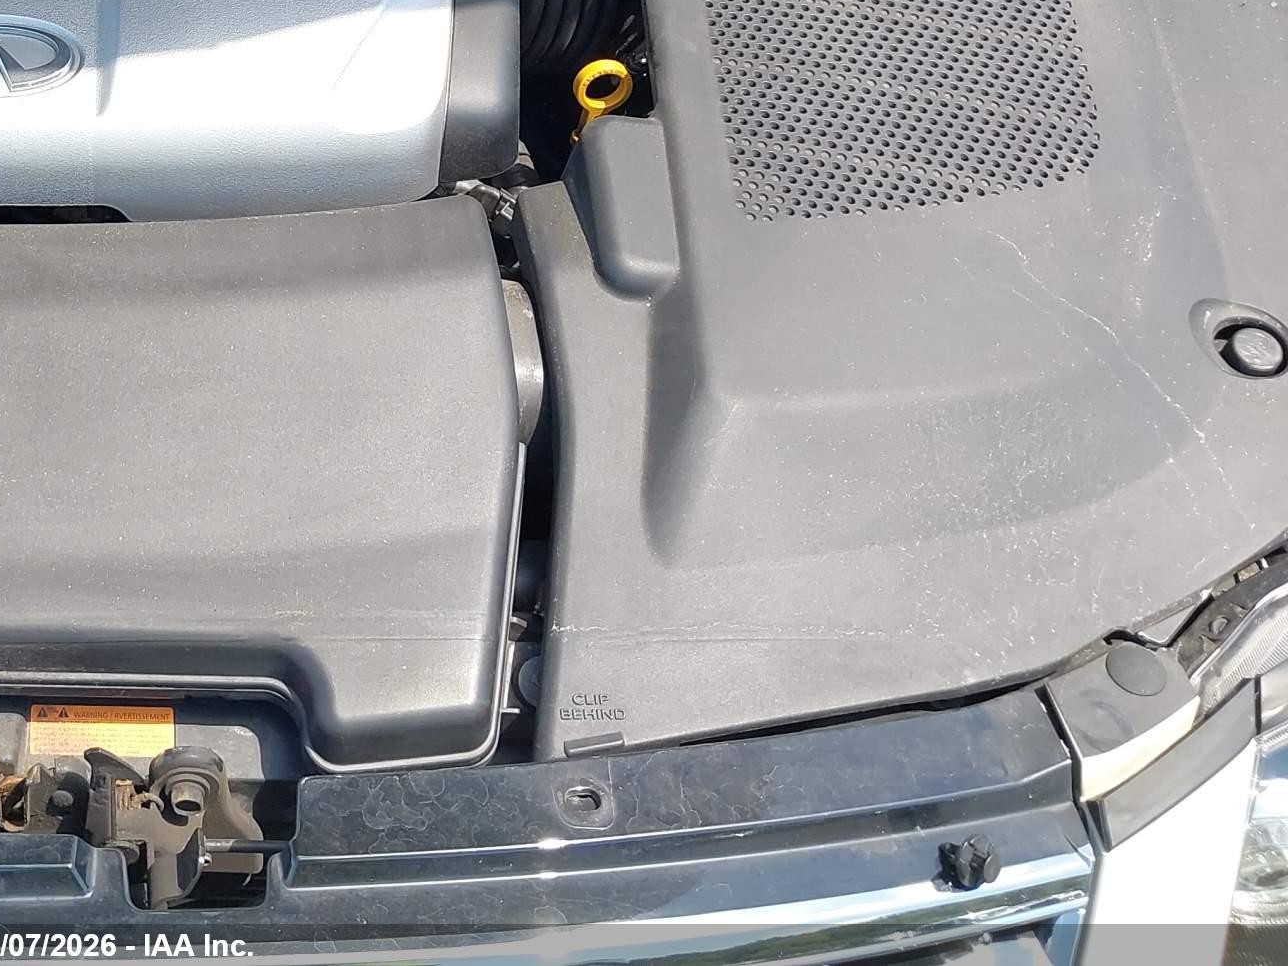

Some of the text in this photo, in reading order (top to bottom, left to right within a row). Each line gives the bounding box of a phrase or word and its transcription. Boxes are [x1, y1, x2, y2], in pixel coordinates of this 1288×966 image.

[571, 694, 609, 706] CLIP
[73, 711, 108, 719] WARNING
[559, 708, 626, 721] BEHIND
